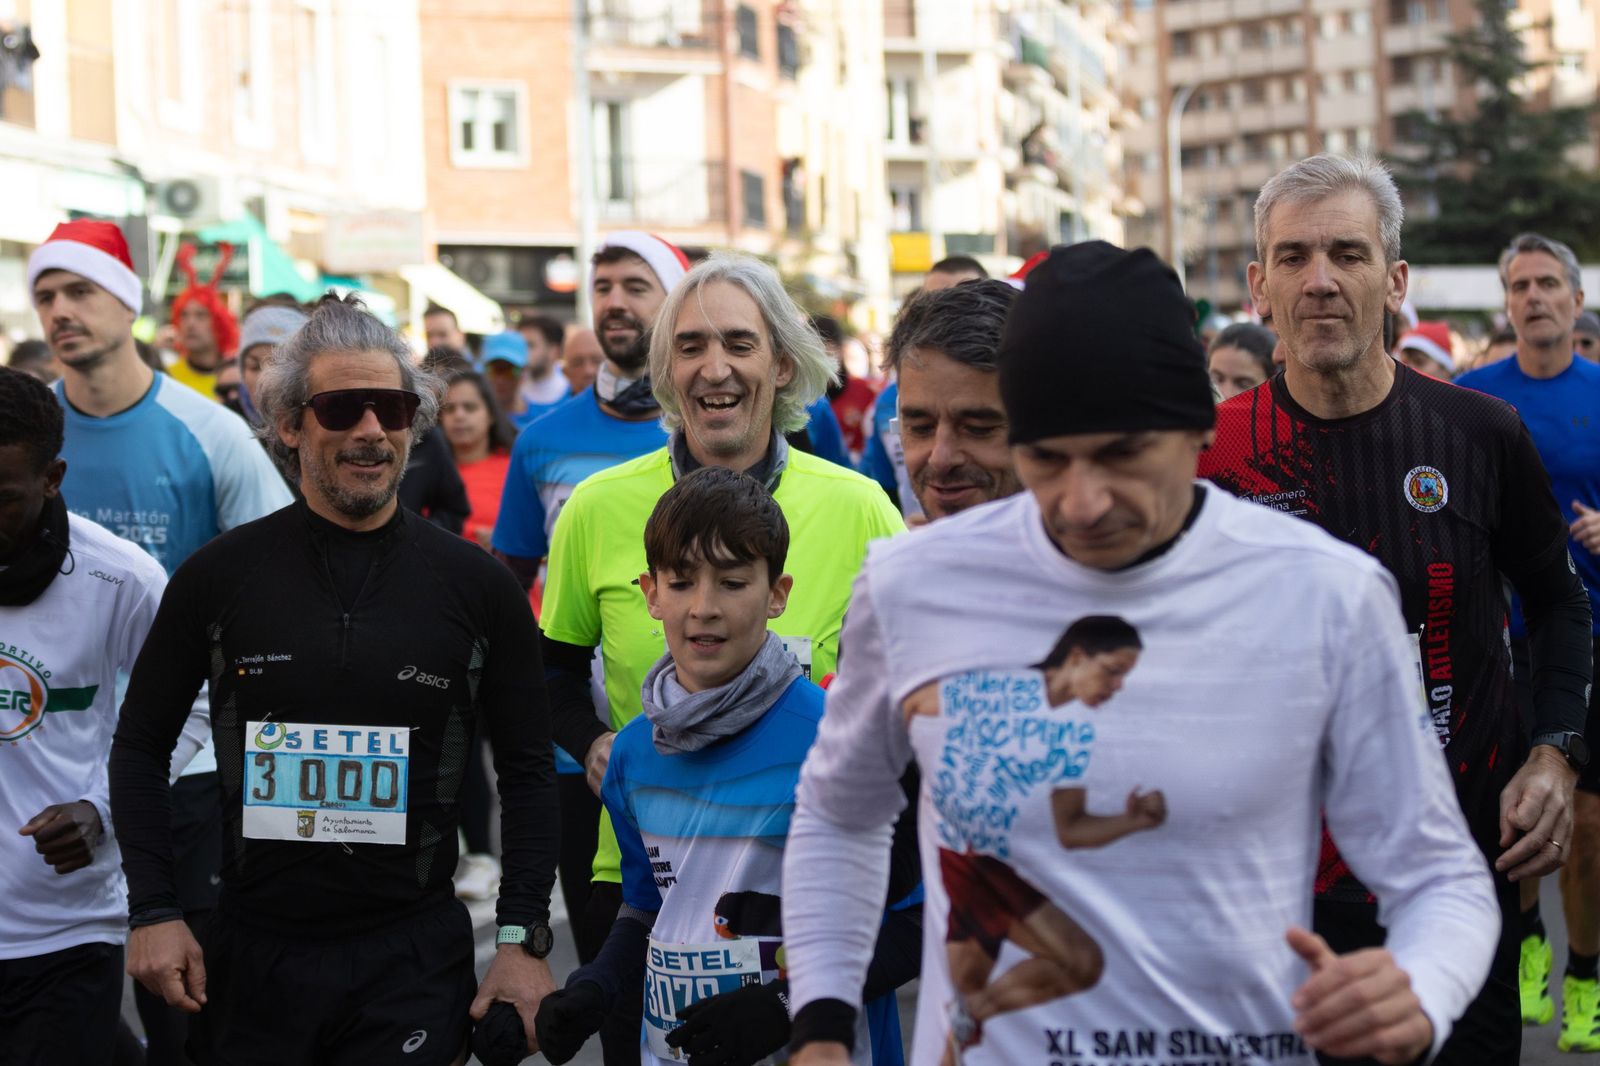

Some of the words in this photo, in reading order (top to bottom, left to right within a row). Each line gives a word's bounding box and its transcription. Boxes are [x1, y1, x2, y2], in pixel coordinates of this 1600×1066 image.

[1252, 489, 1306, 504] Mesonero
[96, 508, 170, 525] Maratón
[116, 524, 168, 544] 2025
[1427, 563, 1455, 680] ATLETISMO
[267, 652, 292, 662] Sánchez
[285, 729, 404, 754] SETEL
[252, 752, 399, 808] 3000
[322, 815, 374, 826] Ayuntamiento
[322, 825, 331, 833] de
[651, 947, 736, 971] SETEL
[1044, 1030, 1082, 1056] XL
[1093, 1030, 1157, 1057] SAN
